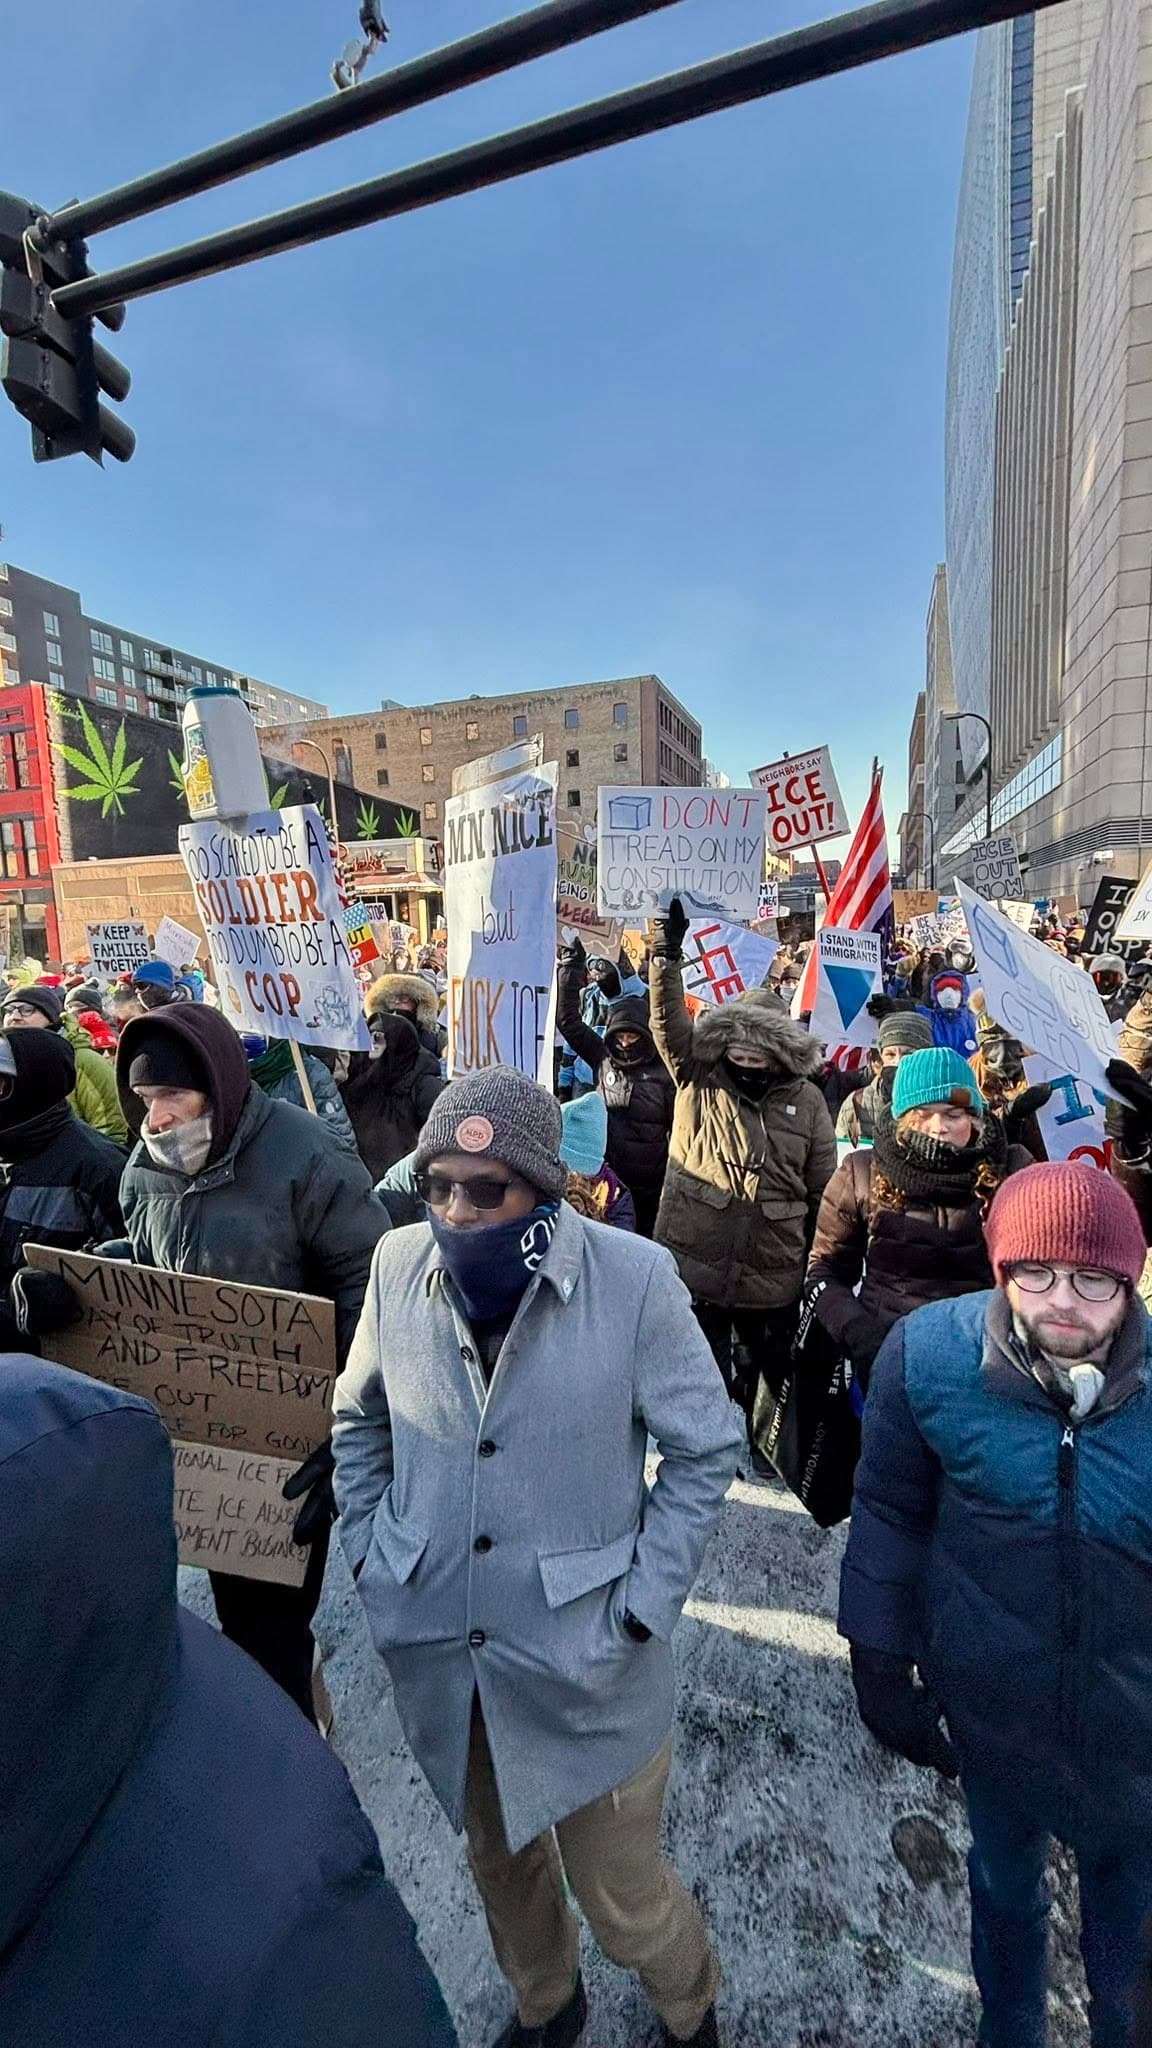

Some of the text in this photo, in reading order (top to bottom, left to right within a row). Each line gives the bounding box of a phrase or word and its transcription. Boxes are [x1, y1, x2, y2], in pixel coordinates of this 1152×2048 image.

[759, 756, 822, 785] NEIGHBORS SAY
[767, 770, 826, 814] ICE
[663, 794, 759, 830] DON'T
[772, 802, 834, 843] OUT!
[448, 795, 553, 866] MN NICE
[180, 820, 324, 881] TOO SCARED TO BE A
[602, 834, 760, 864] TREAD ON MY
[971, 836, 1015, 863] ICE
[607, 866, 755, 895] CONSTITUTION
[975, 858, 1018, 881] OUT
[195, 871, 325, 925] SOLDIER
[976, 878, 1023, 899] NOW
[366, 904, 385, 920] STOP
[480, 890, 520, 945] but
[103, 926, 130, 940] KEEP
[229, 926, 279, 968] DUMB
[276, 923, 300, 966] TO
[301, 922, 328, 967] BE
[330, 920, 351, 968] A
[820, 934, 878, 951] I STAND WITH
[1090, 930, 1142, 958] MSP
[93, 942, 148, 958] FAMILIES
[821, 945, 878, 963] IMMIGRANTS
[245, 971, 301, 1017] COP
[451, 977, 504, 1072] FUCK
[59, 1258, 324, 1344] MINNESOTA
[134, 1314, 162, 1334] OF
[174, 1323, 302, 1364] TRUTH
[97, 1335, 331, 1408] AND FREEDOM
[154, 1384, 217, 1412] OUT
[208, 1422, 247, 1438] FOR
[238, 1459, 270, 1484] ICE
[216, 1494, 246, 1521] ICE
